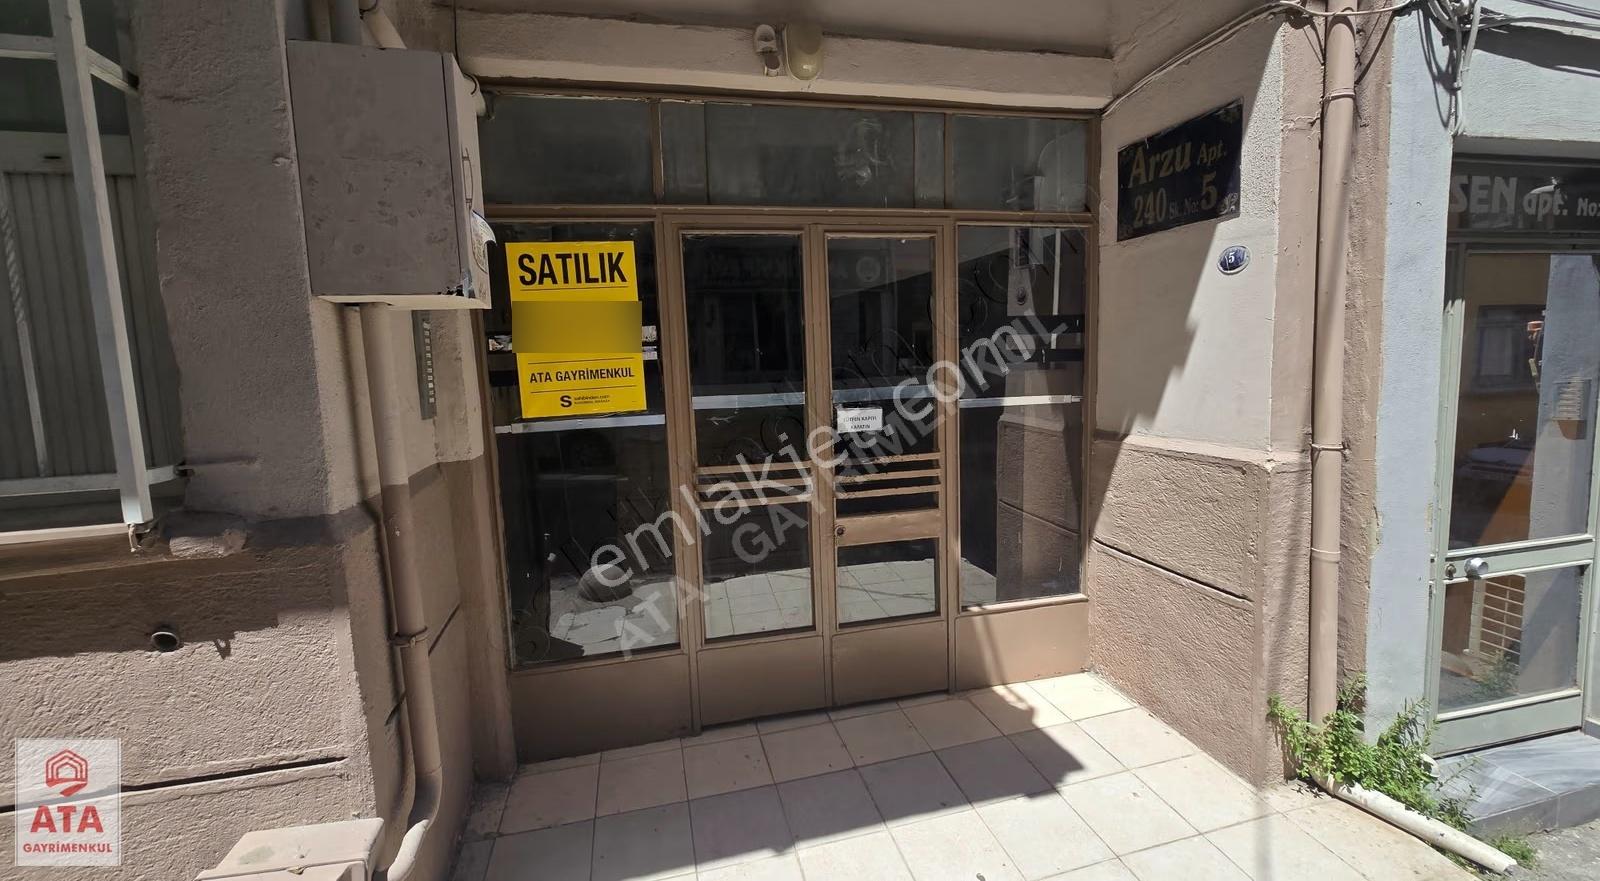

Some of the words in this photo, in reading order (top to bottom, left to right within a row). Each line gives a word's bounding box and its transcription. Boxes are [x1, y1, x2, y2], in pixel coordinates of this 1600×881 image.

[1128, 141, 1192, 188] Arzu
[1196, 140, 1227, 166] Apt.
[1133, 187, 1167, 228] 240
[1200, 171, 1218, 211] 5
[518, 251, 627, 286] SATILIK
[1228, 254, 1235, 264] 5
[529, 372, 553, 384] ATA
[555, 366, 635, 382] GAYRİMENKUL
